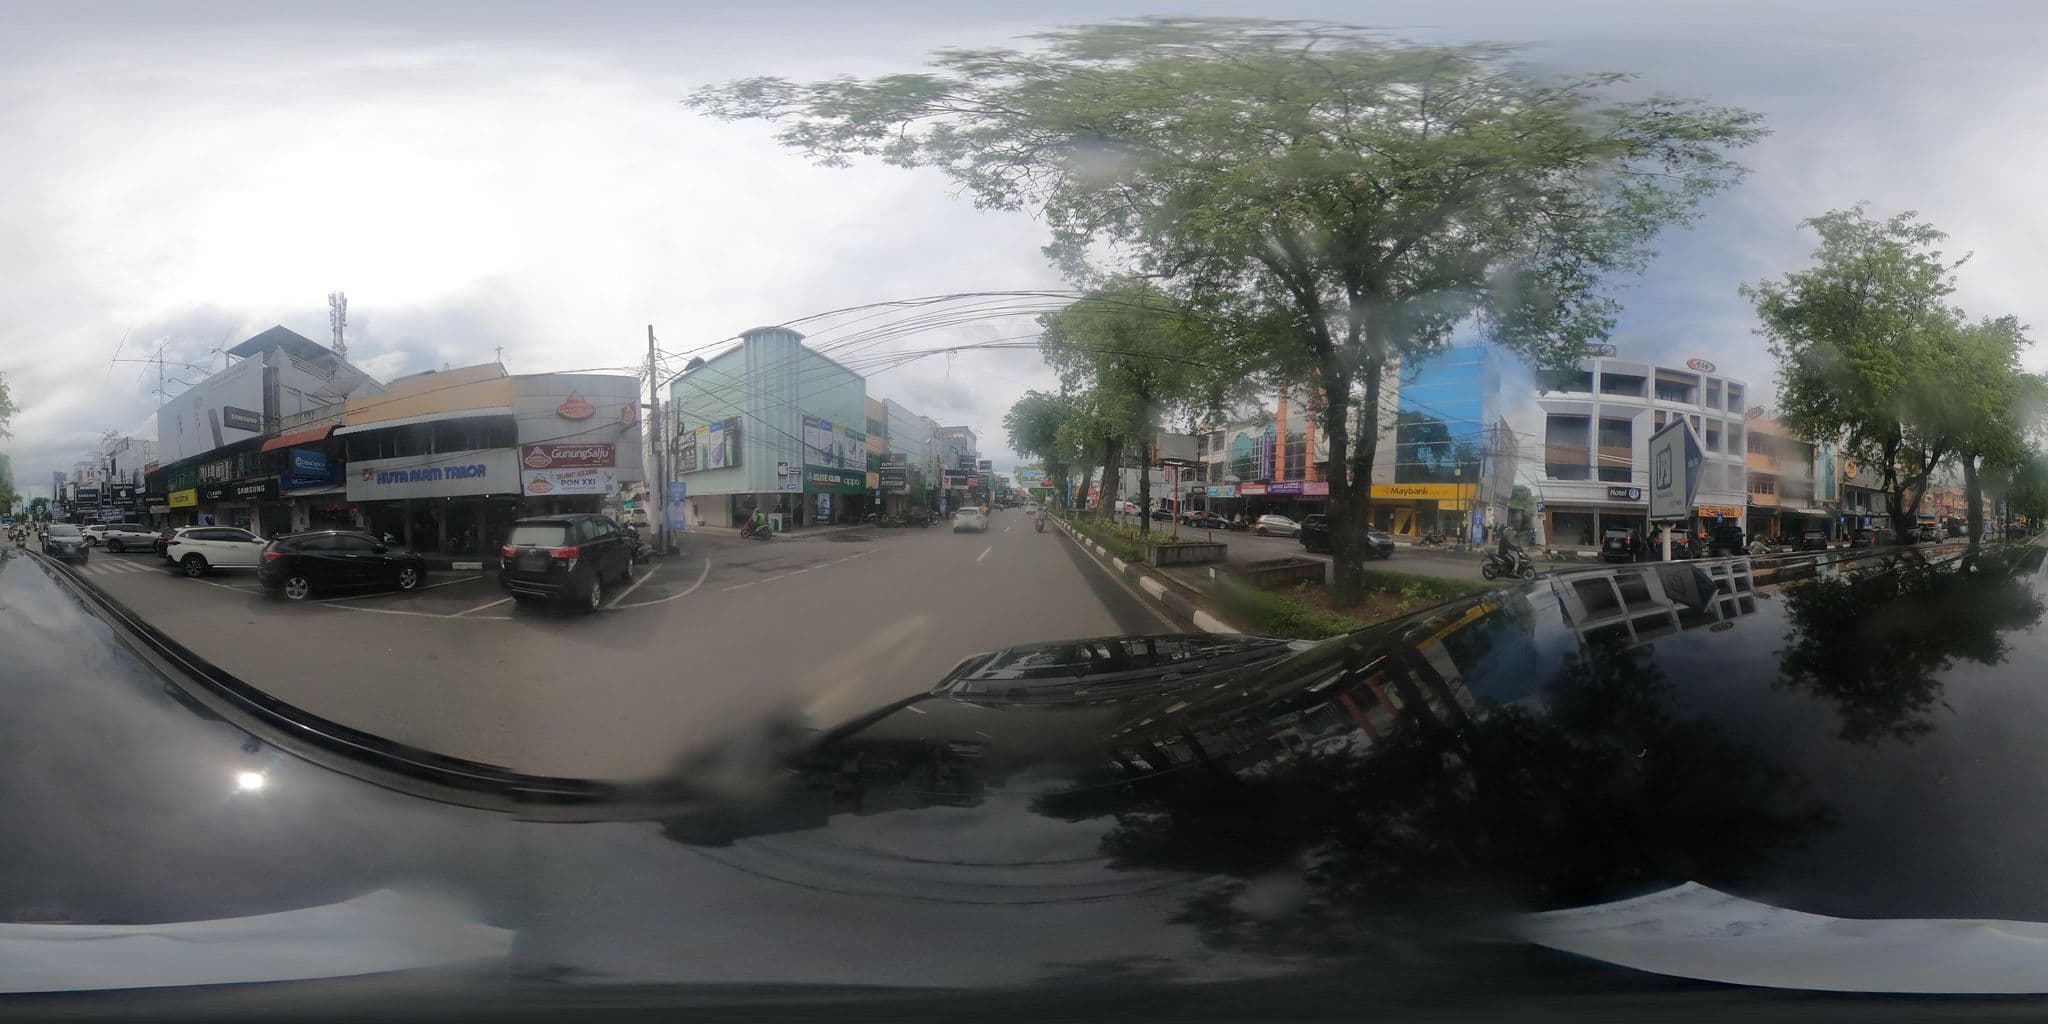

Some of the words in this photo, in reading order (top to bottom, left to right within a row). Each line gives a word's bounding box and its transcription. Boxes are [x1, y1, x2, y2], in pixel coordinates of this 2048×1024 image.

[236, 484, 265, 495] SAMSUNG
[1390, 487, 1428, 496] Maybank
[1609, 488, 1627, 496] Hotel
